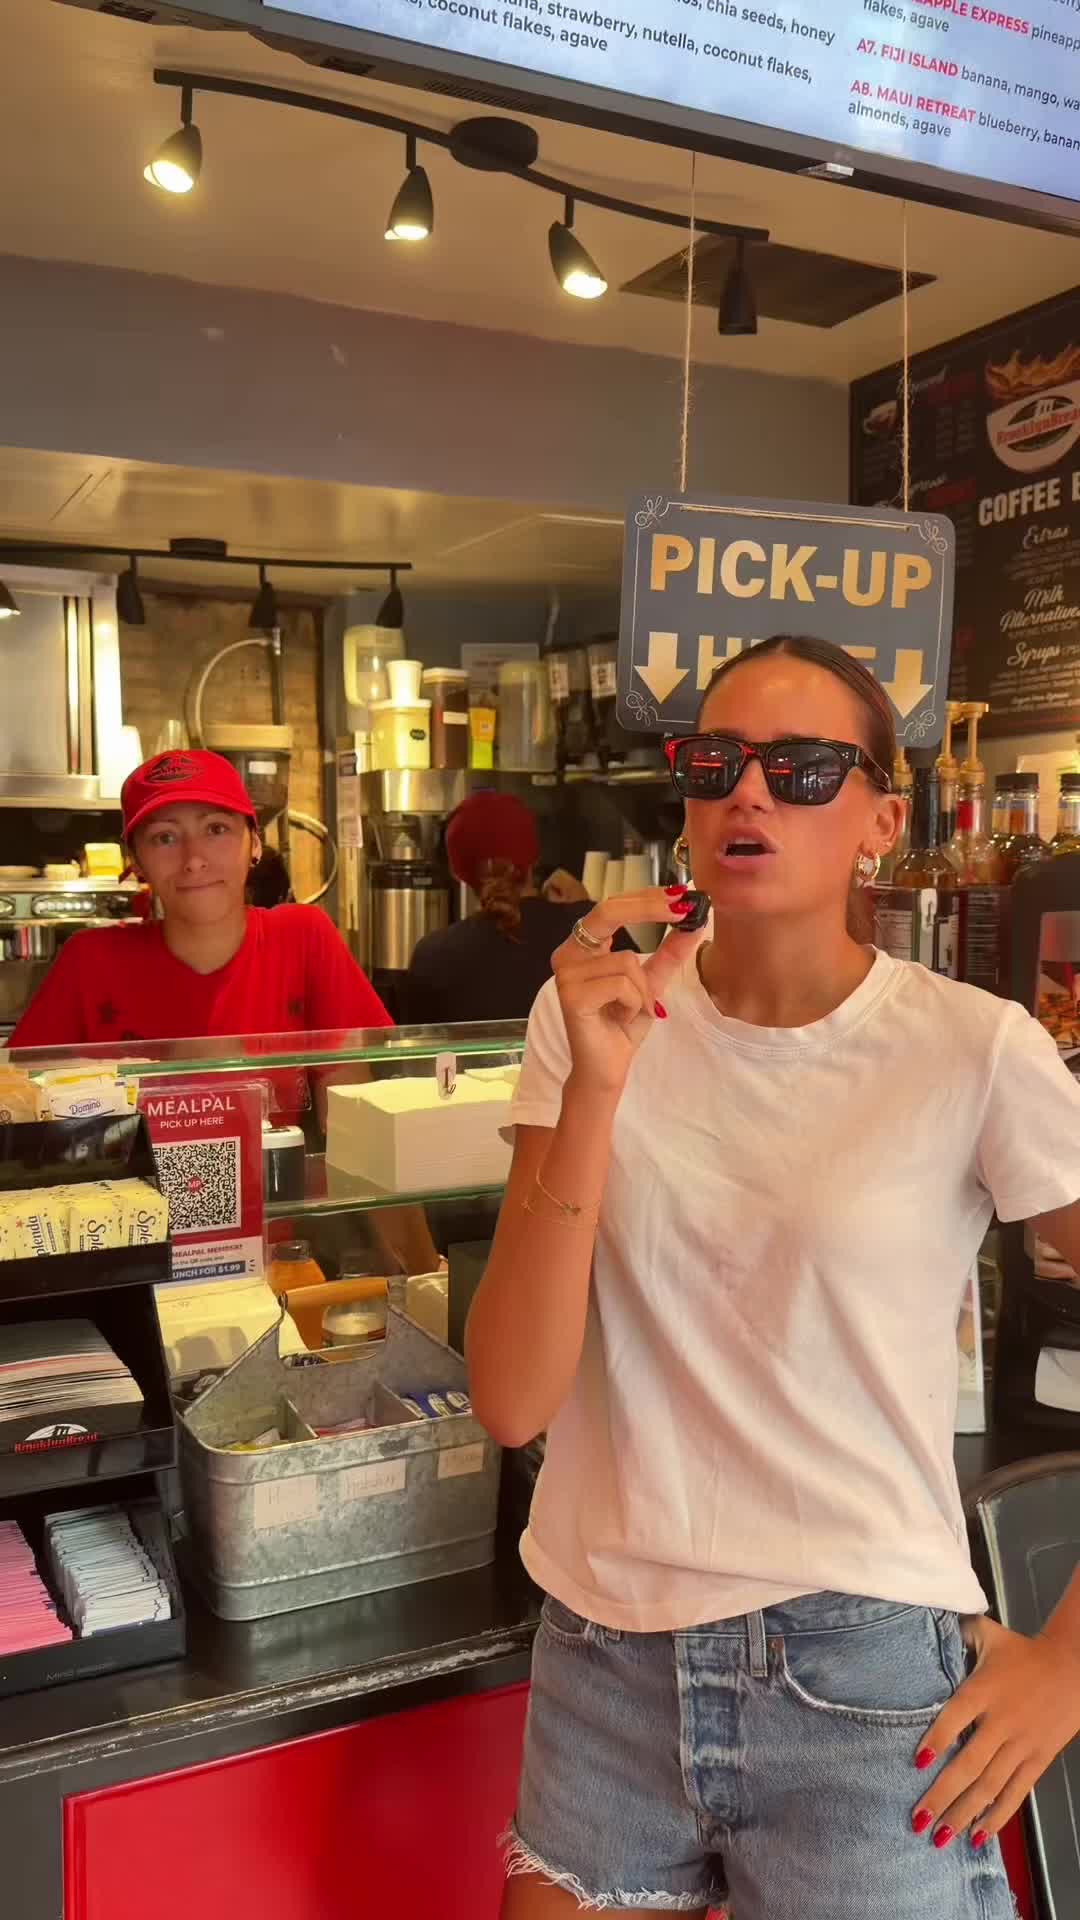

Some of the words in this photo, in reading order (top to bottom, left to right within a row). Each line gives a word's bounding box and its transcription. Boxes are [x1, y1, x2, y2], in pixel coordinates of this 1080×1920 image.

[428, 0, 498, 25] coconut
[503, 11, 555, 41] flakes,
[560, 29, 608, 51] agave
[706, 0, 738, 18] chia
[741, 8, 787, 34] seeds,
[790, 18, 836, 46] honey
[909, 11, 949, 33] agave
[971, 6, 1029, 35] EXPRESS
[546, 3, 638, 39] strawberry,
[642, 26, 699, 55] nutella,
[703, 43, 764, 69] coconut
[767, 57, 813, 85] flakes,
[856, 38, 877, 56] A7.
[881, 44, 905, 64] FIJI
[908, 50, 959, 77] ISLAND
[961, 66, 1011, 94] banana,
[1014, 83, 1060, 109] mango,
[848, 101, 909, 130] almonds,
[912, 118, 952, 138] agave
[850, 79, 873, 98] A8.
[876, 84, 913, 108] MAUI
[916, 96, 977, 124] RETREAT
[978, 111, 1041, 143] blueberry,
[978, 477, 1061, 527] COFFEE
[648, 532, 933, 609] PICK-UP
[147, 1095, 236, 1117] MEALPAL
[160, 1119, 182, 1129] PICK
[184, 1118, 198, 1128] UP
[200, 1116, 225, 1127] HERE
[172, 1268, 198, 1280] UNCH
[200, 1265, 216, 1276] FOR
